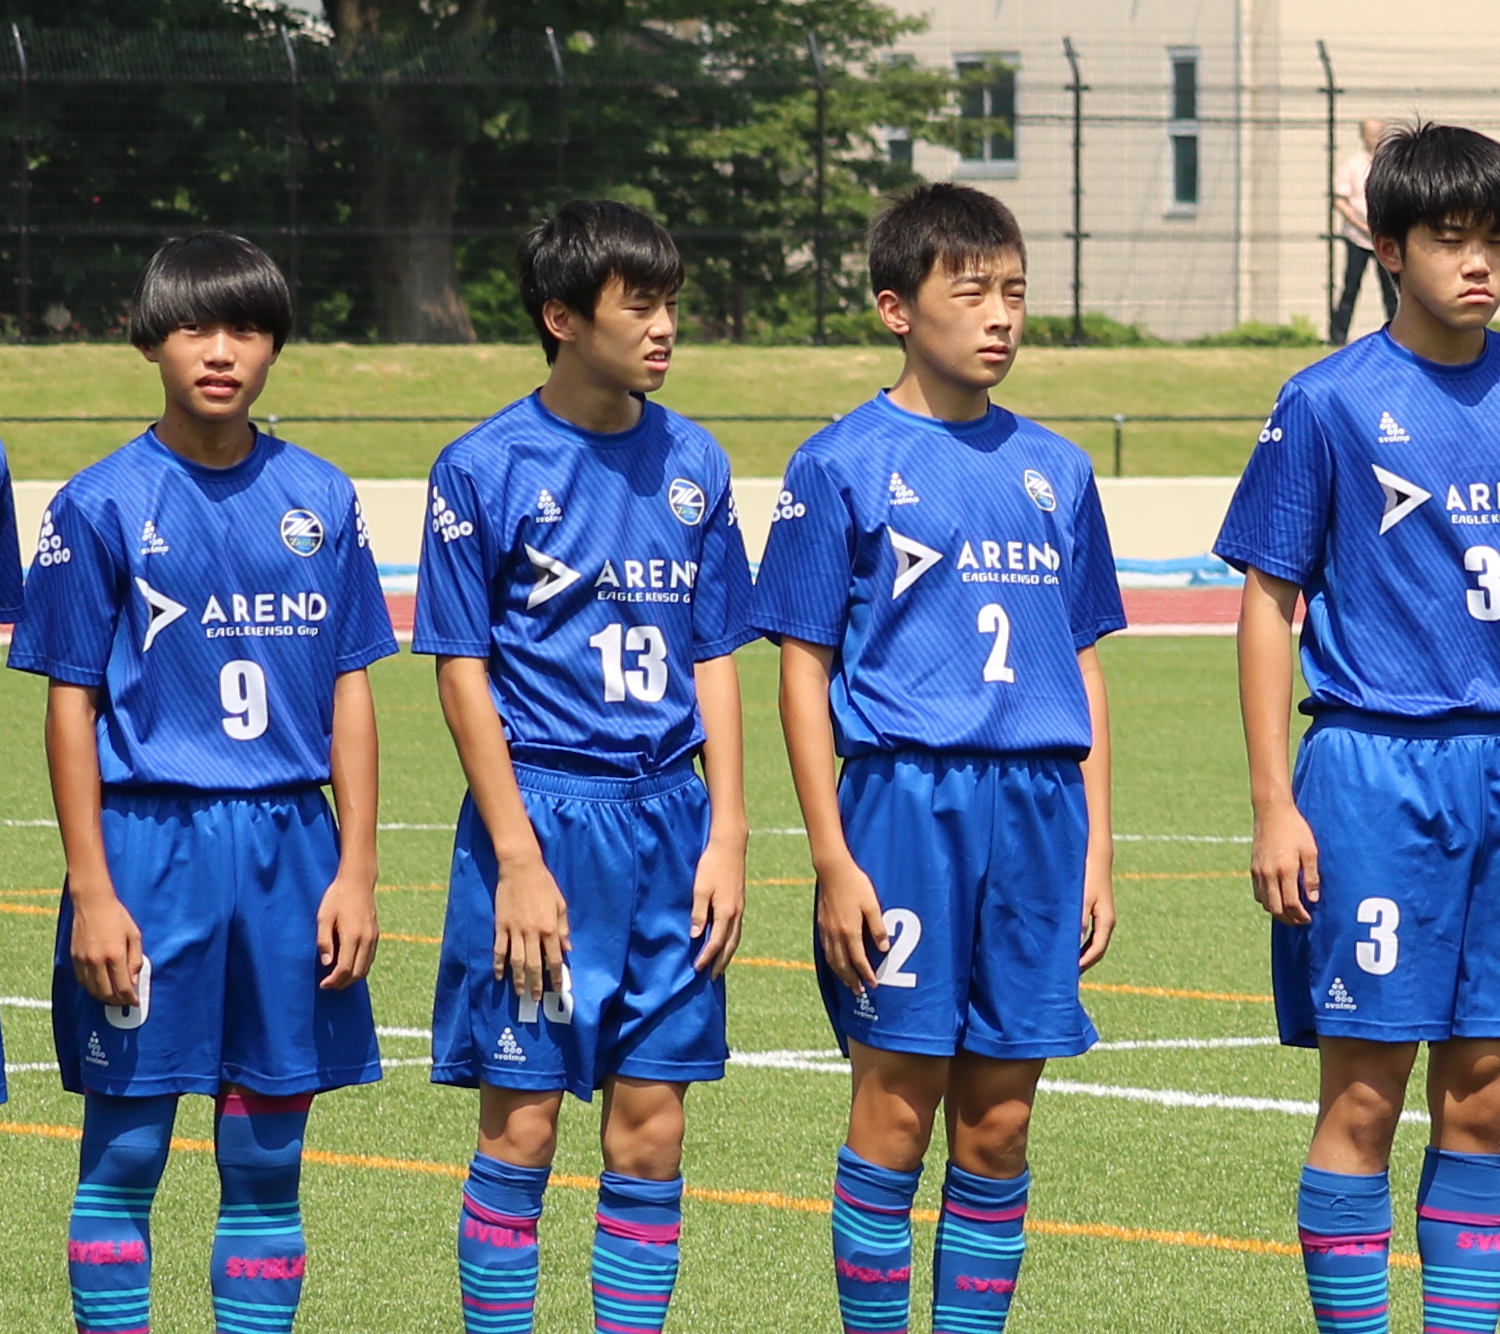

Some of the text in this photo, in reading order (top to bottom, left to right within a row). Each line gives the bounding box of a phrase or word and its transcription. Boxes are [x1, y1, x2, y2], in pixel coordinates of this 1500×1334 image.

[1451, 513, 1490, 524] EAGLE
[200, 592, 328, 625] AREND
[597, 591, 643, 603] EAGLE
[962, 572, 1000, 583] EAGLE
[1001, 573, 1039, 585] KENSO
[589, 623, 668, 703] 13
[977, 603, 1015, 683] 2
[218, 659, 269, 741] 9
[875, 907, 923, 989] 2
[1355, 897, 1400, 976] 3
